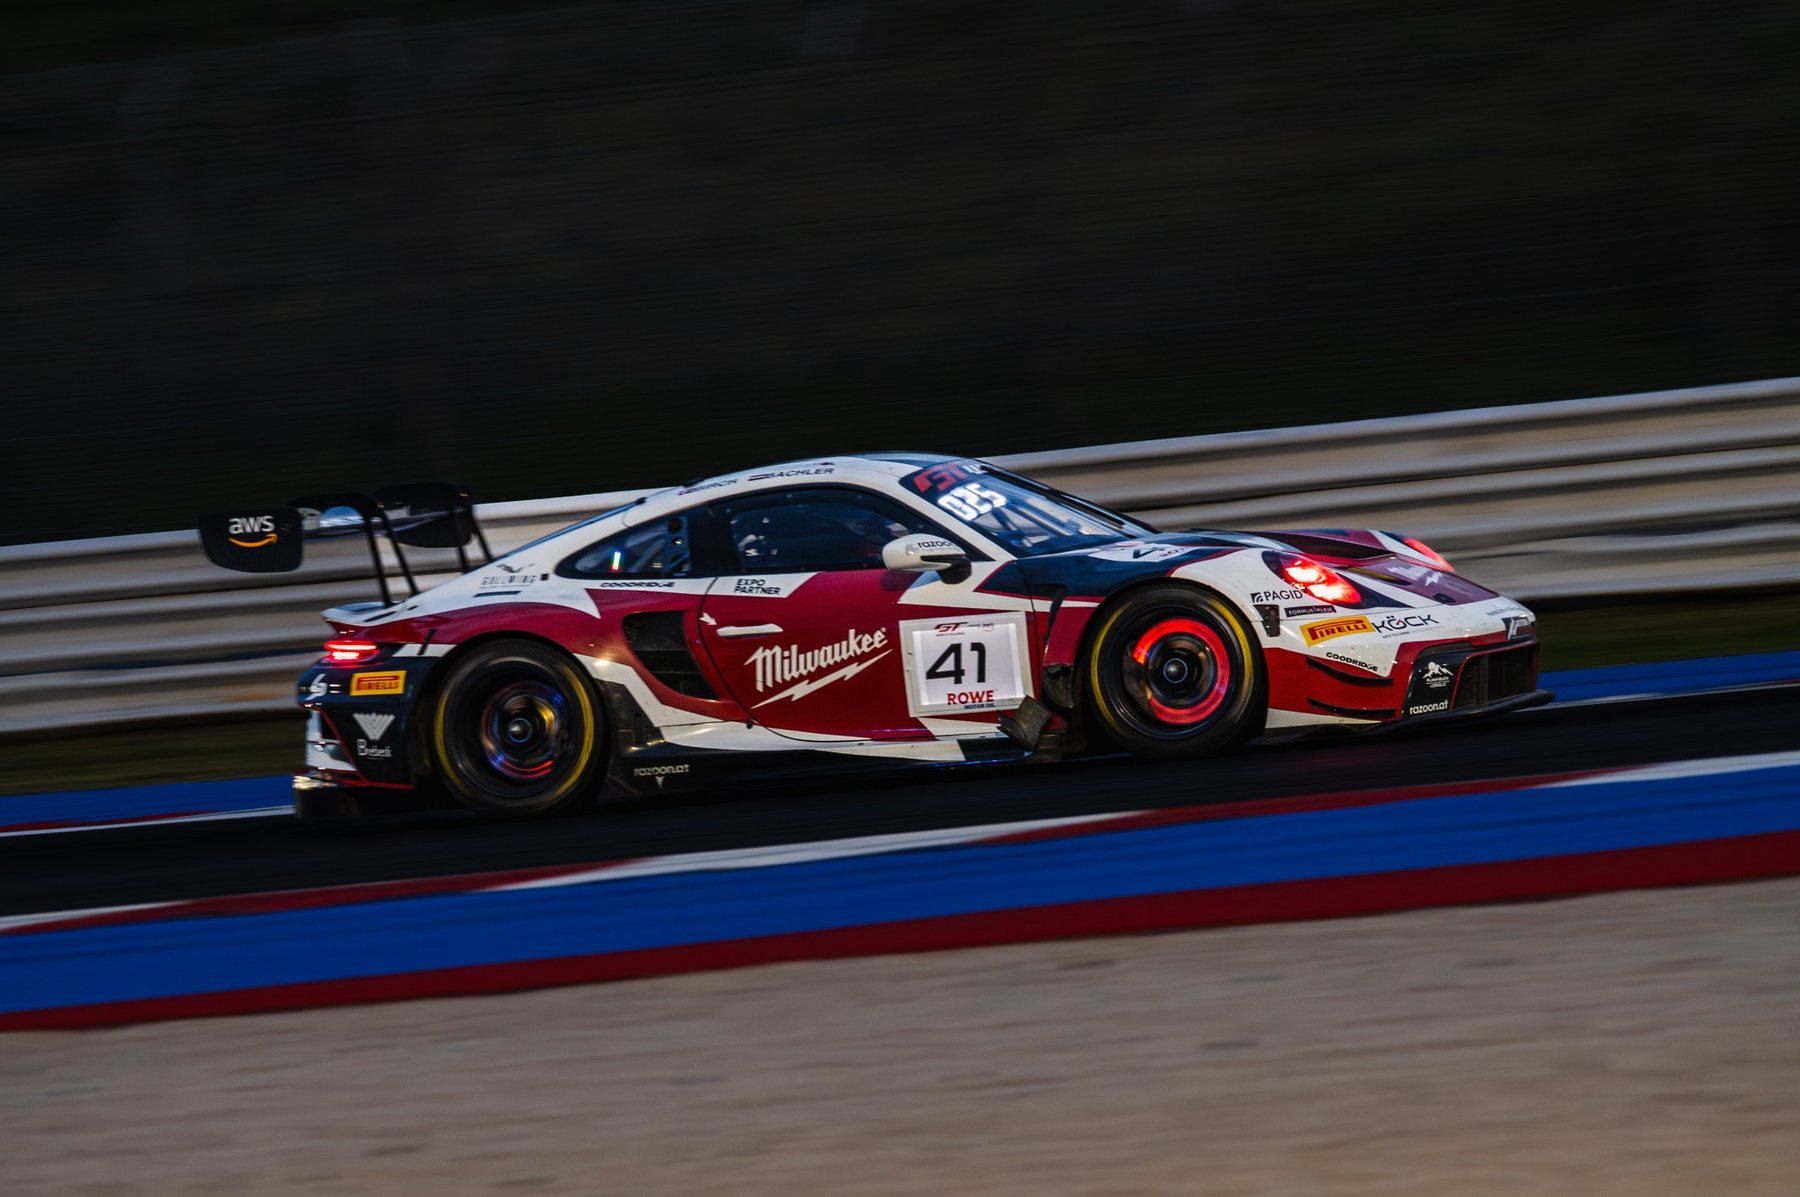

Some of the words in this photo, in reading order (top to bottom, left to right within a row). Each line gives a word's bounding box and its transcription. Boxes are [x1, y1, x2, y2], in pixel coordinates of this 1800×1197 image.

[938, 482, 1008, 521] 025
[228, 515, 275, 534] aws
[917, 540, 953, 549] razoo
[734, 585, 781, 595] PARTNER
[737, 578, 766, 587] EXPO
[1265, 588, 1303, 601] PAGID
[1307, 619, 1368, 641] PIRELLI
[744, 627, 888, 692] Milwaukee
[926, 642, 986, 685] 41
[1326, 651, 1379, 672] GOODRIDGE
[947, 690, 995, 705] ROWE
[1409, 700, 1449, 715] razoon.at
